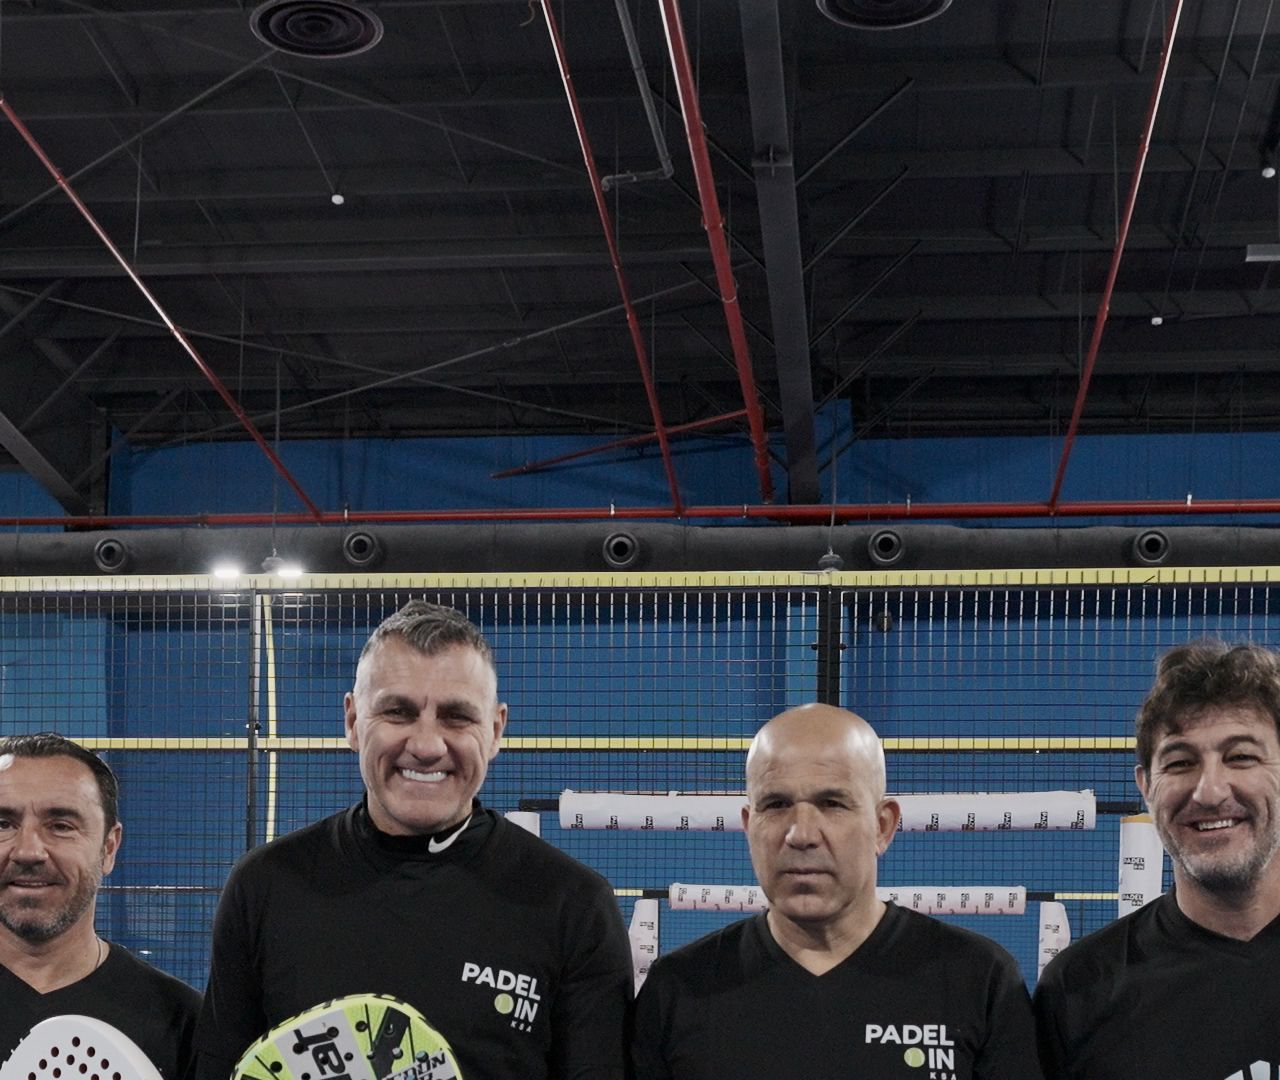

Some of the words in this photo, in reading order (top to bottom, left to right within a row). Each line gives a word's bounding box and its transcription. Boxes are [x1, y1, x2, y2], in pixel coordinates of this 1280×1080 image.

[461, 962, 541, 1002] PADEL
[514, 997, 539, 1023] IN
[864, 1023, 956, 1047] PADEL
[927, 1047, 956, 1071] IN
